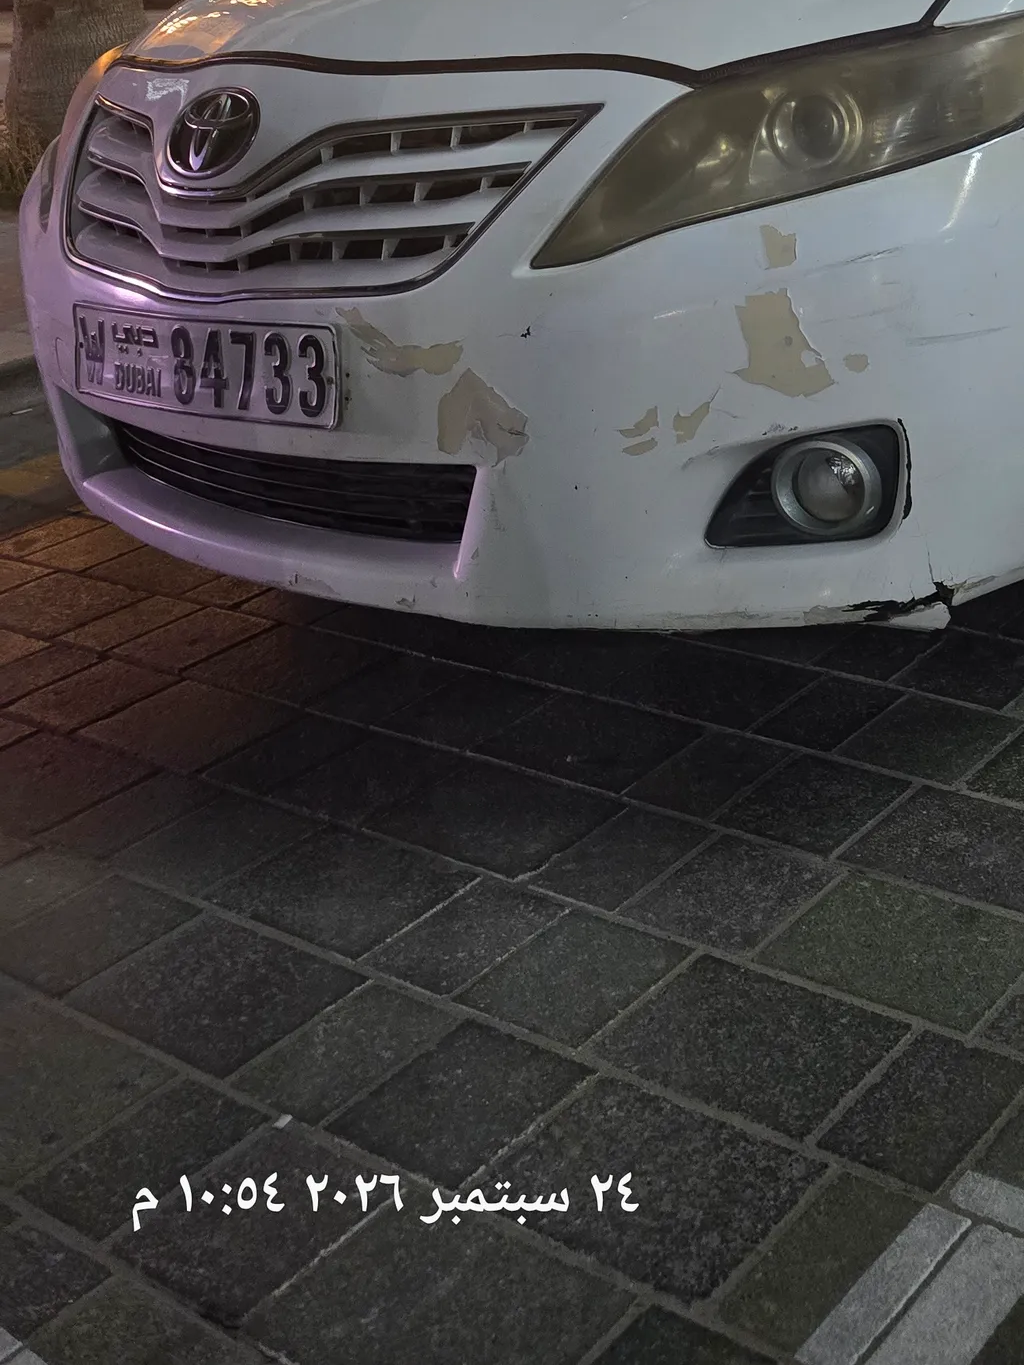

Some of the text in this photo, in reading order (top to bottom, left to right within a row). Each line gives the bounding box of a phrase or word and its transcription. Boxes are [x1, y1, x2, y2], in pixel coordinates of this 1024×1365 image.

[111, 321, 159, 357] دبي
[114, 362, 161, 398] DUBAI
[170, 324, 327, 418] 84733
